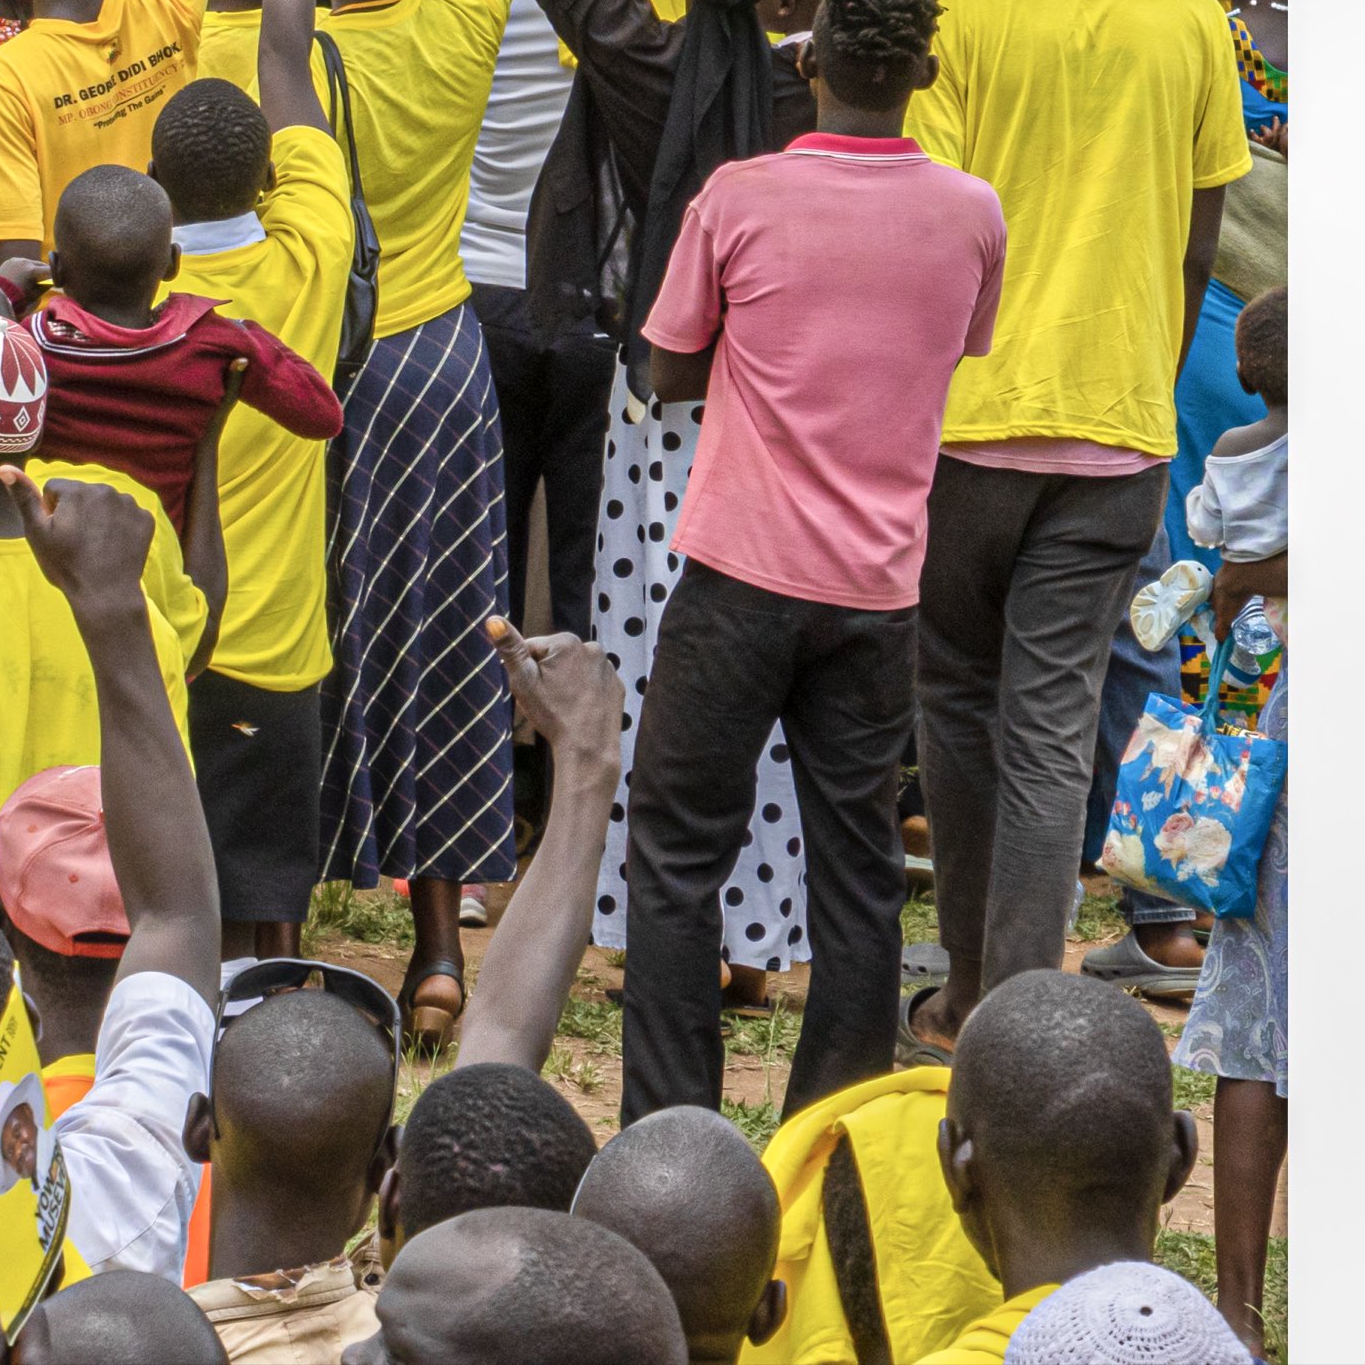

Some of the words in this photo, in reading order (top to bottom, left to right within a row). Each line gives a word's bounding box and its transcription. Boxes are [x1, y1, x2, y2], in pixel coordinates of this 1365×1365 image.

[54, 94, 77, 109] DR.
[117, 60, 147, 82] DIDI
[127, 101, 143, 115] The
[58, 112, 78, 125] MP.
